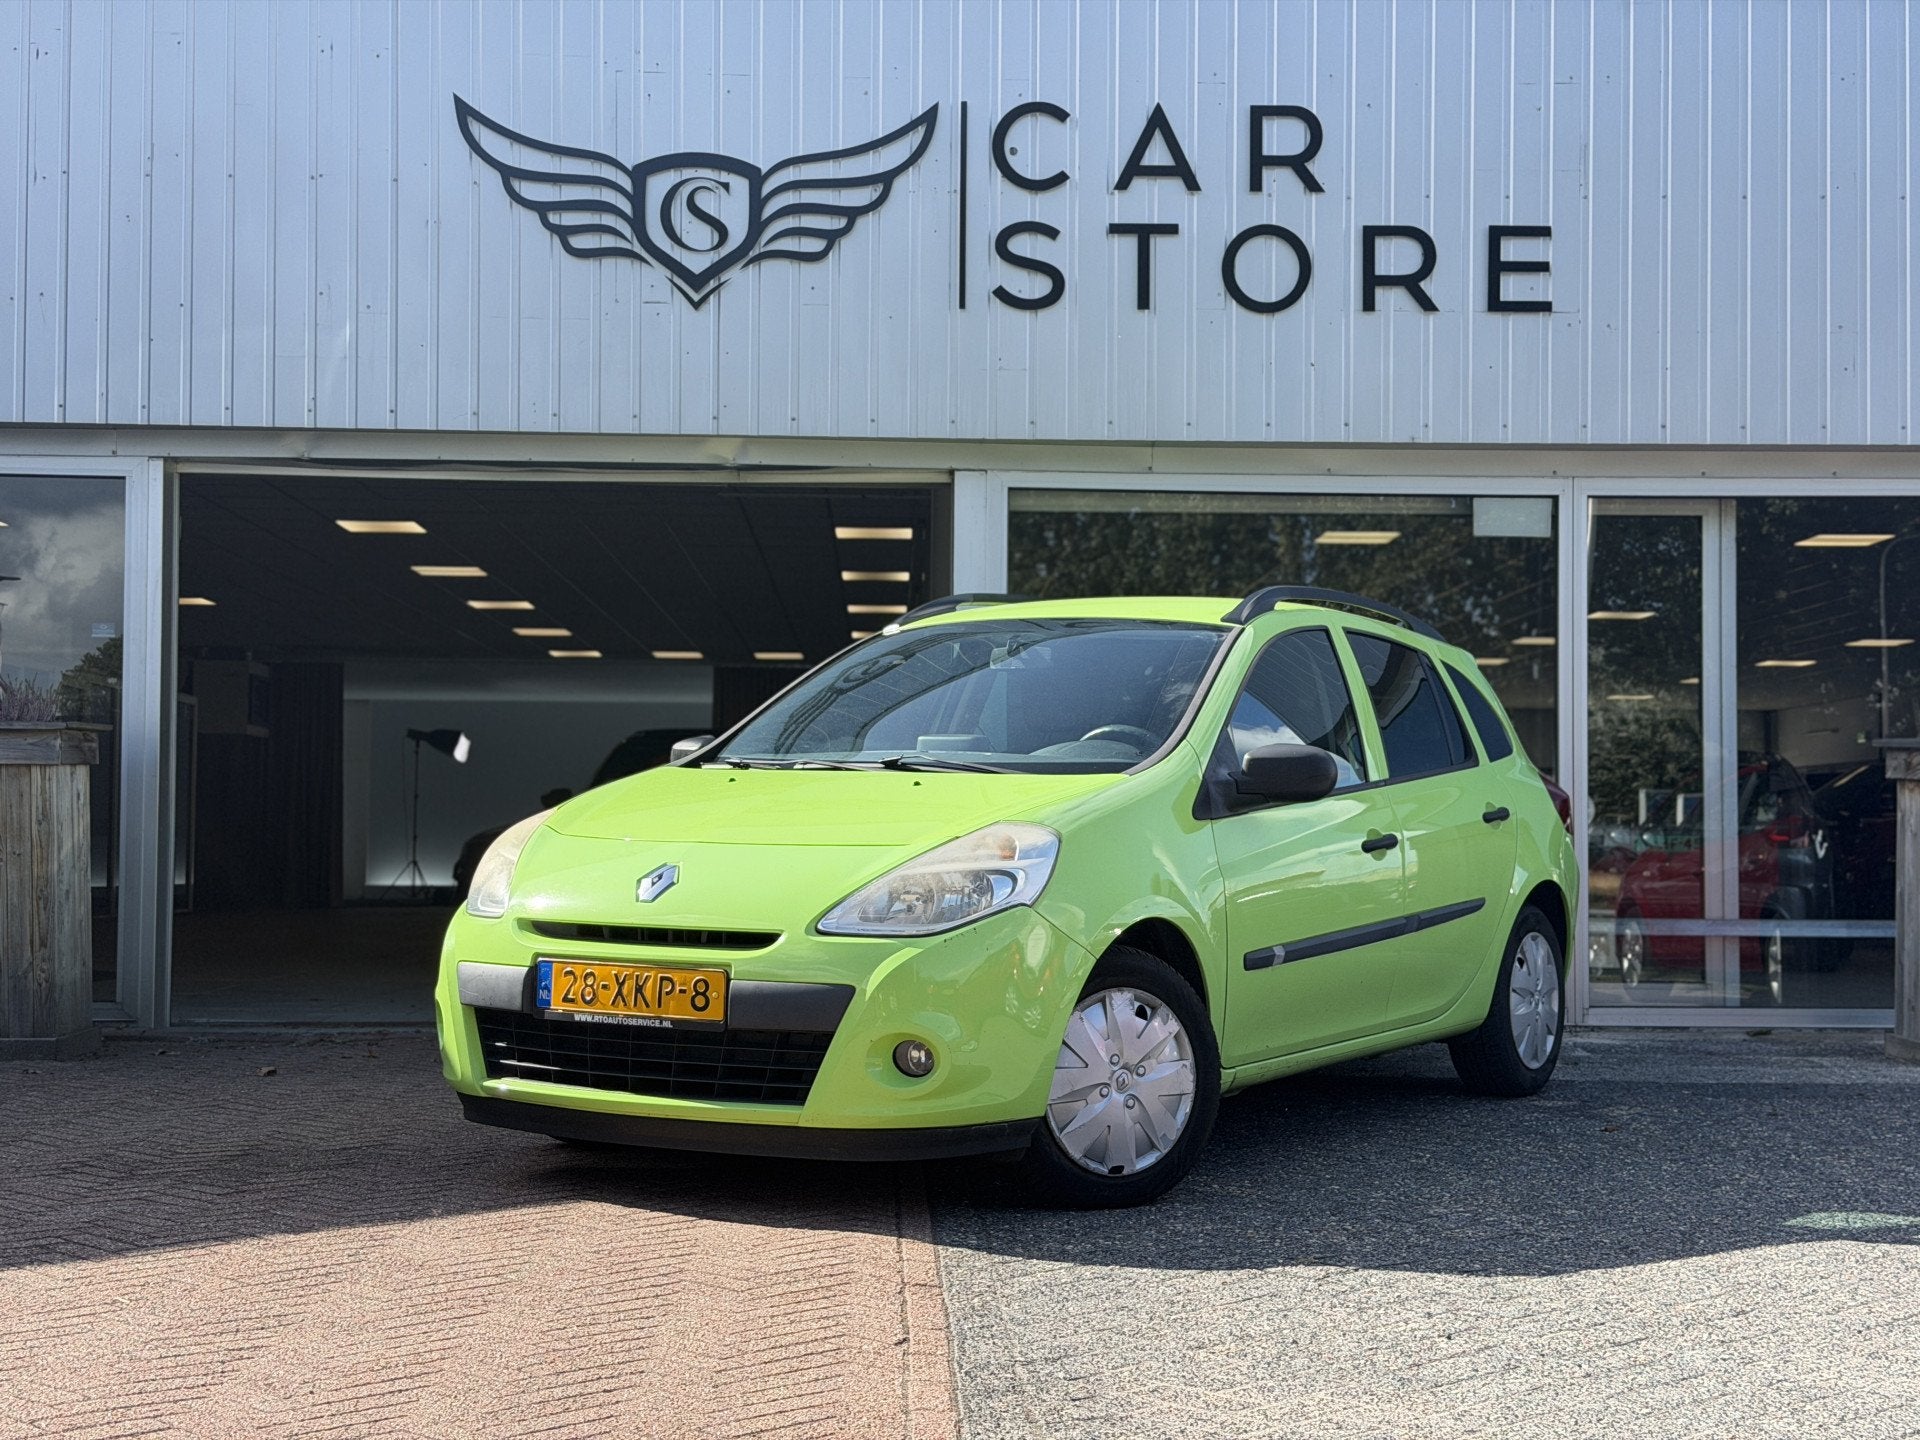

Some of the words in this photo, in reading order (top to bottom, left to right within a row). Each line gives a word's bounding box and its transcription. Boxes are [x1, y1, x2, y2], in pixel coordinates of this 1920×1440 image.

[992, 101, 1325, 192] CAR
[992, 220, 1553, 314] STORE
[539, 989, 551, 1000] NL
[561, 968, 711, 1012] 28-XKP-8
